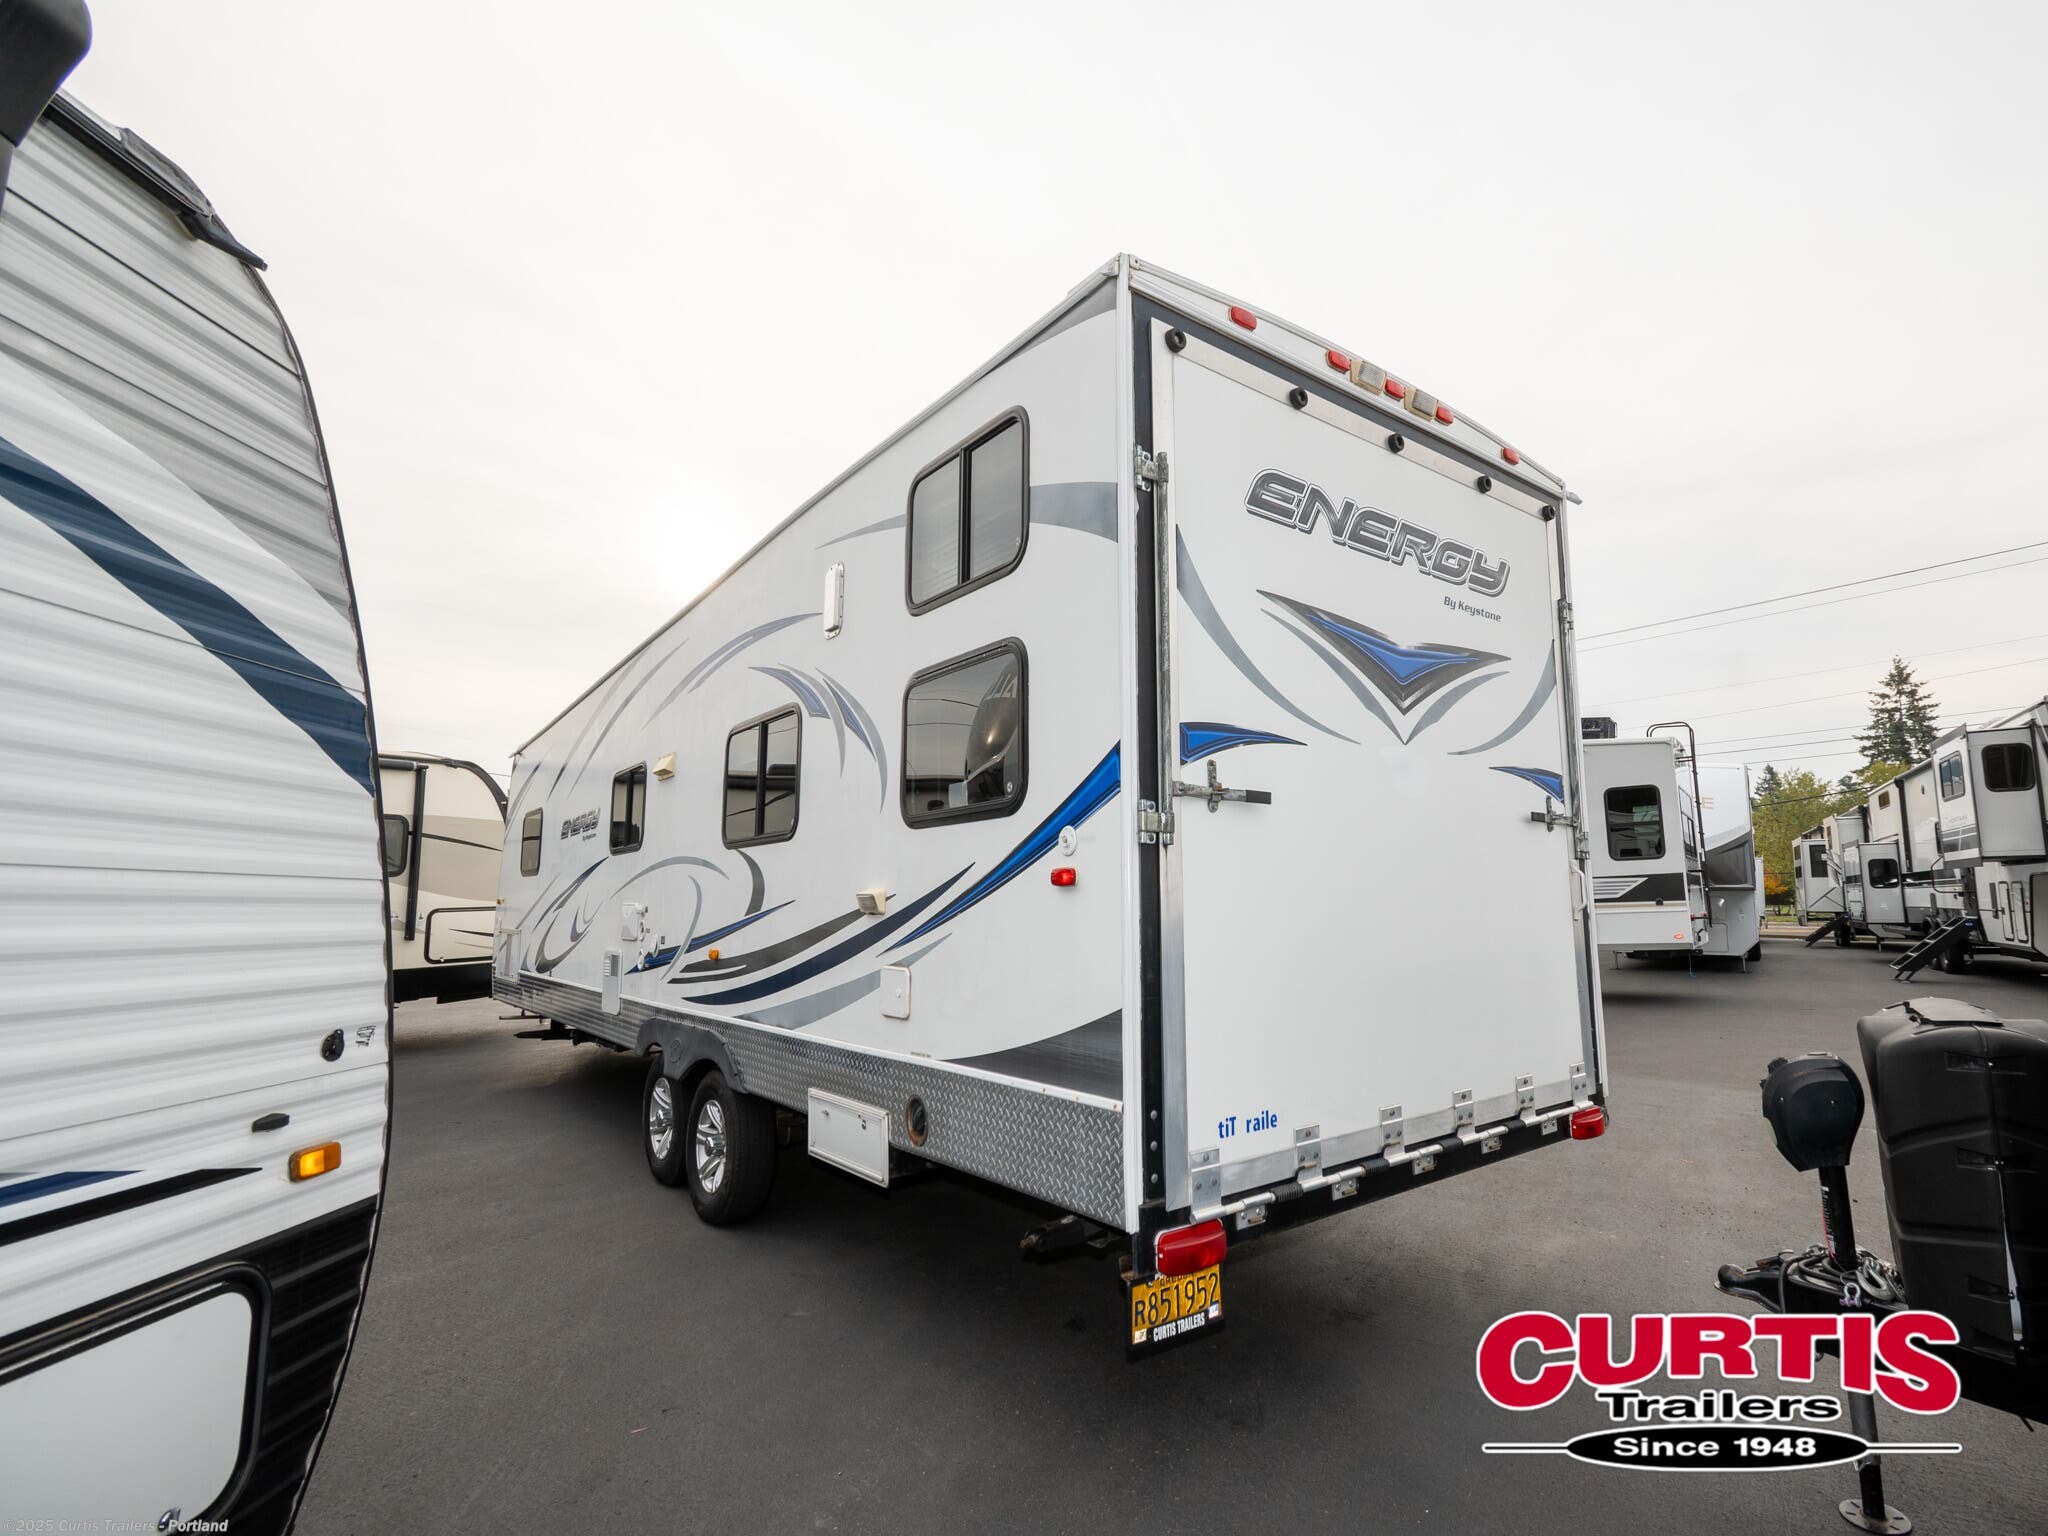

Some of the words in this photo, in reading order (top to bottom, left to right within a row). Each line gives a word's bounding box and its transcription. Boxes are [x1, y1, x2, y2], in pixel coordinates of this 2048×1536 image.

[1244, 468, 1511, 598] ENERGY
[1443, 596, 1456, 610] By
[1458, 600, 1502, 622] Keystone
[1246, 1110, 1278, 1133] raile
[1134, 1272, 1220, 1327] R851952
[1153, 1322, 1177, 1342] CURTIS
[1177, 1312, 1206, 1333] TRAILERS
